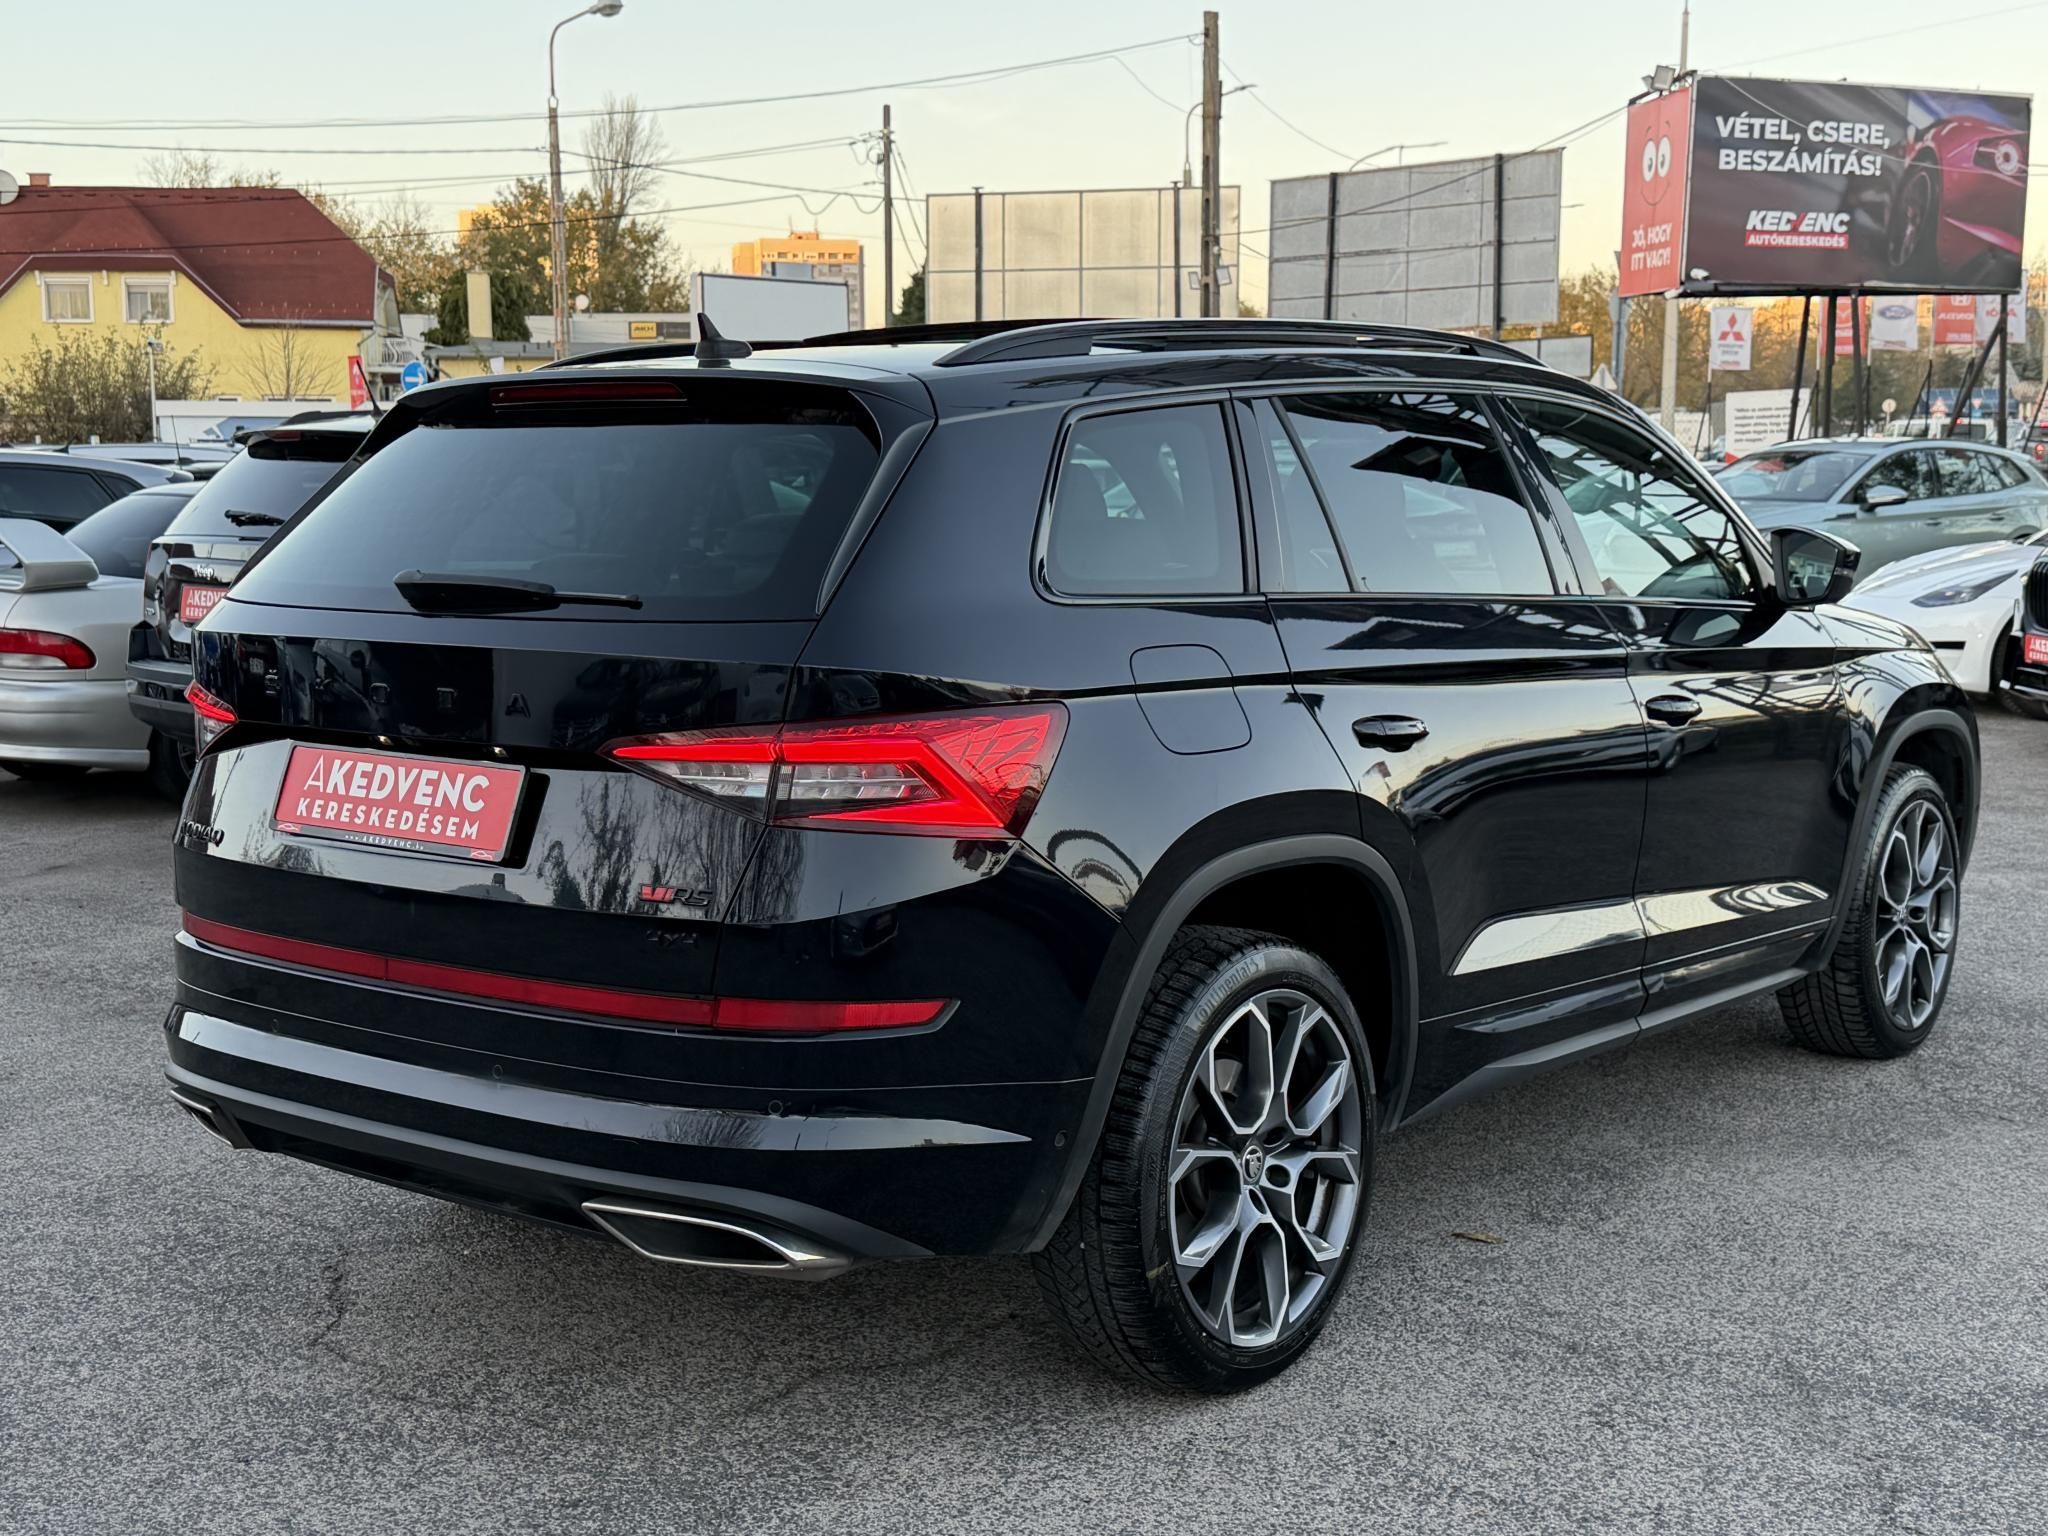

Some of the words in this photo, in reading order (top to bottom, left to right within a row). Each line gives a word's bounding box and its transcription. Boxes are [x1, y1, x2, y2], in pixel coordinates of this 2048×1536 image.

[1716, 111, 1800, 145] VÉTEL,
[1807, 120, 1890, 149] CSERE,
[1719, 146, 1882, 176] BESZÁMÍTÁS!
[1648, 222, 1672, 244] HOGY
[1748, 233, 1846, 247] AUTÓKERESKEDÉS
[1631, 252, 1645, 271] ITT
[304, 755, 490, 812] AKEDVENC
[297, 798, 480, 840] KERESKEDÉSEM
